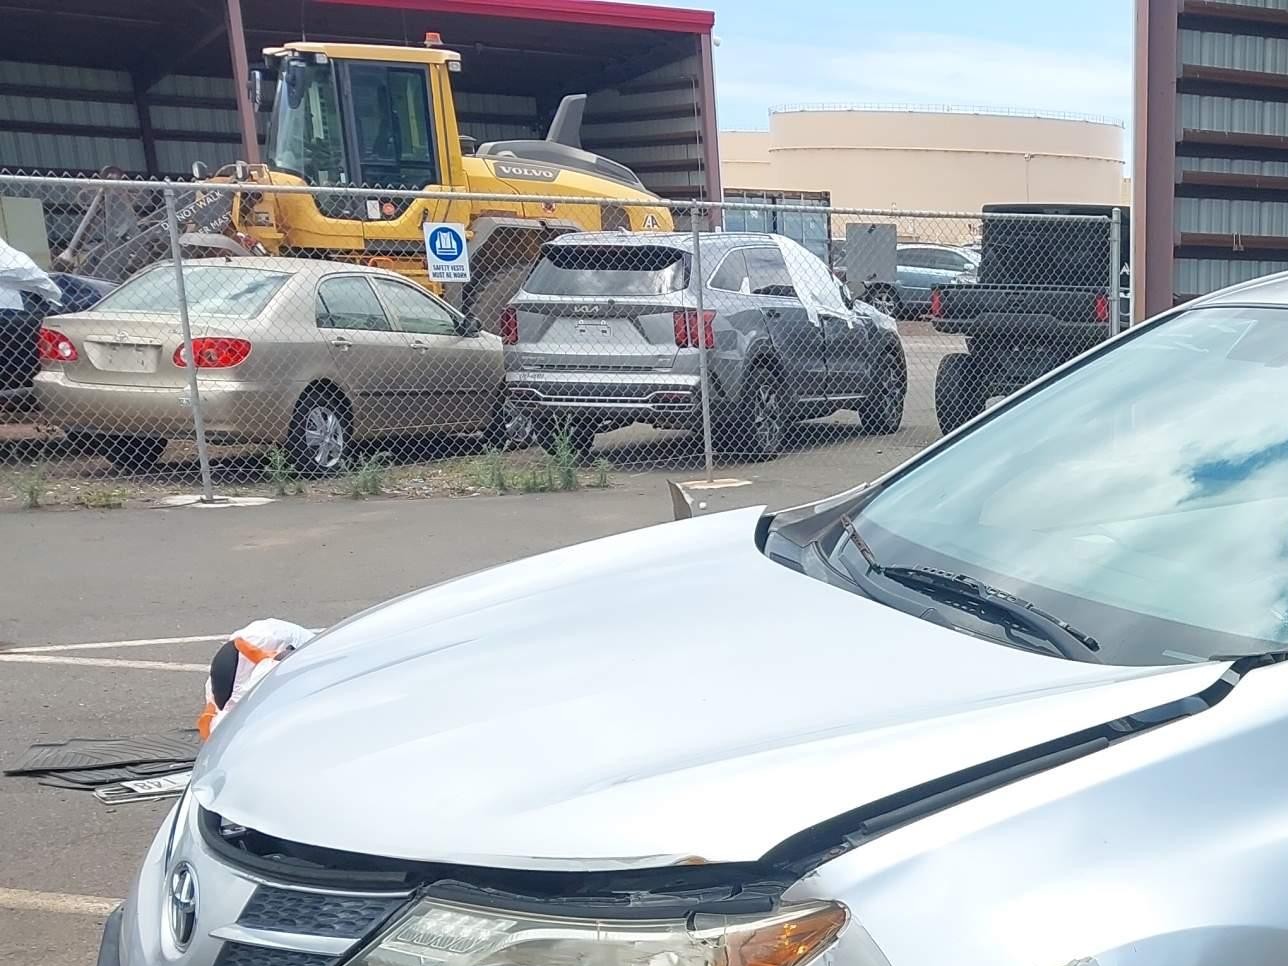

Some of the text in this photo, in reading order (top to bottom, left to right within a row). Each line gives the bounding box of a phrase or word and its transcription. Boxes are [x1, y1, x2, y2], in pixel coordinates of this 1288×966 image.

[500, 165, 553, 178] VOLVO
[176, 206, 198, 222] NOT
[196, 190, 224, 209] WALK
[210, 211, 233, 229] MAST
[432, 264, 465, 272] SAFETY VESTS
[432, 271, 445, 279] MUST
[445, 271, 452, 279] BE
